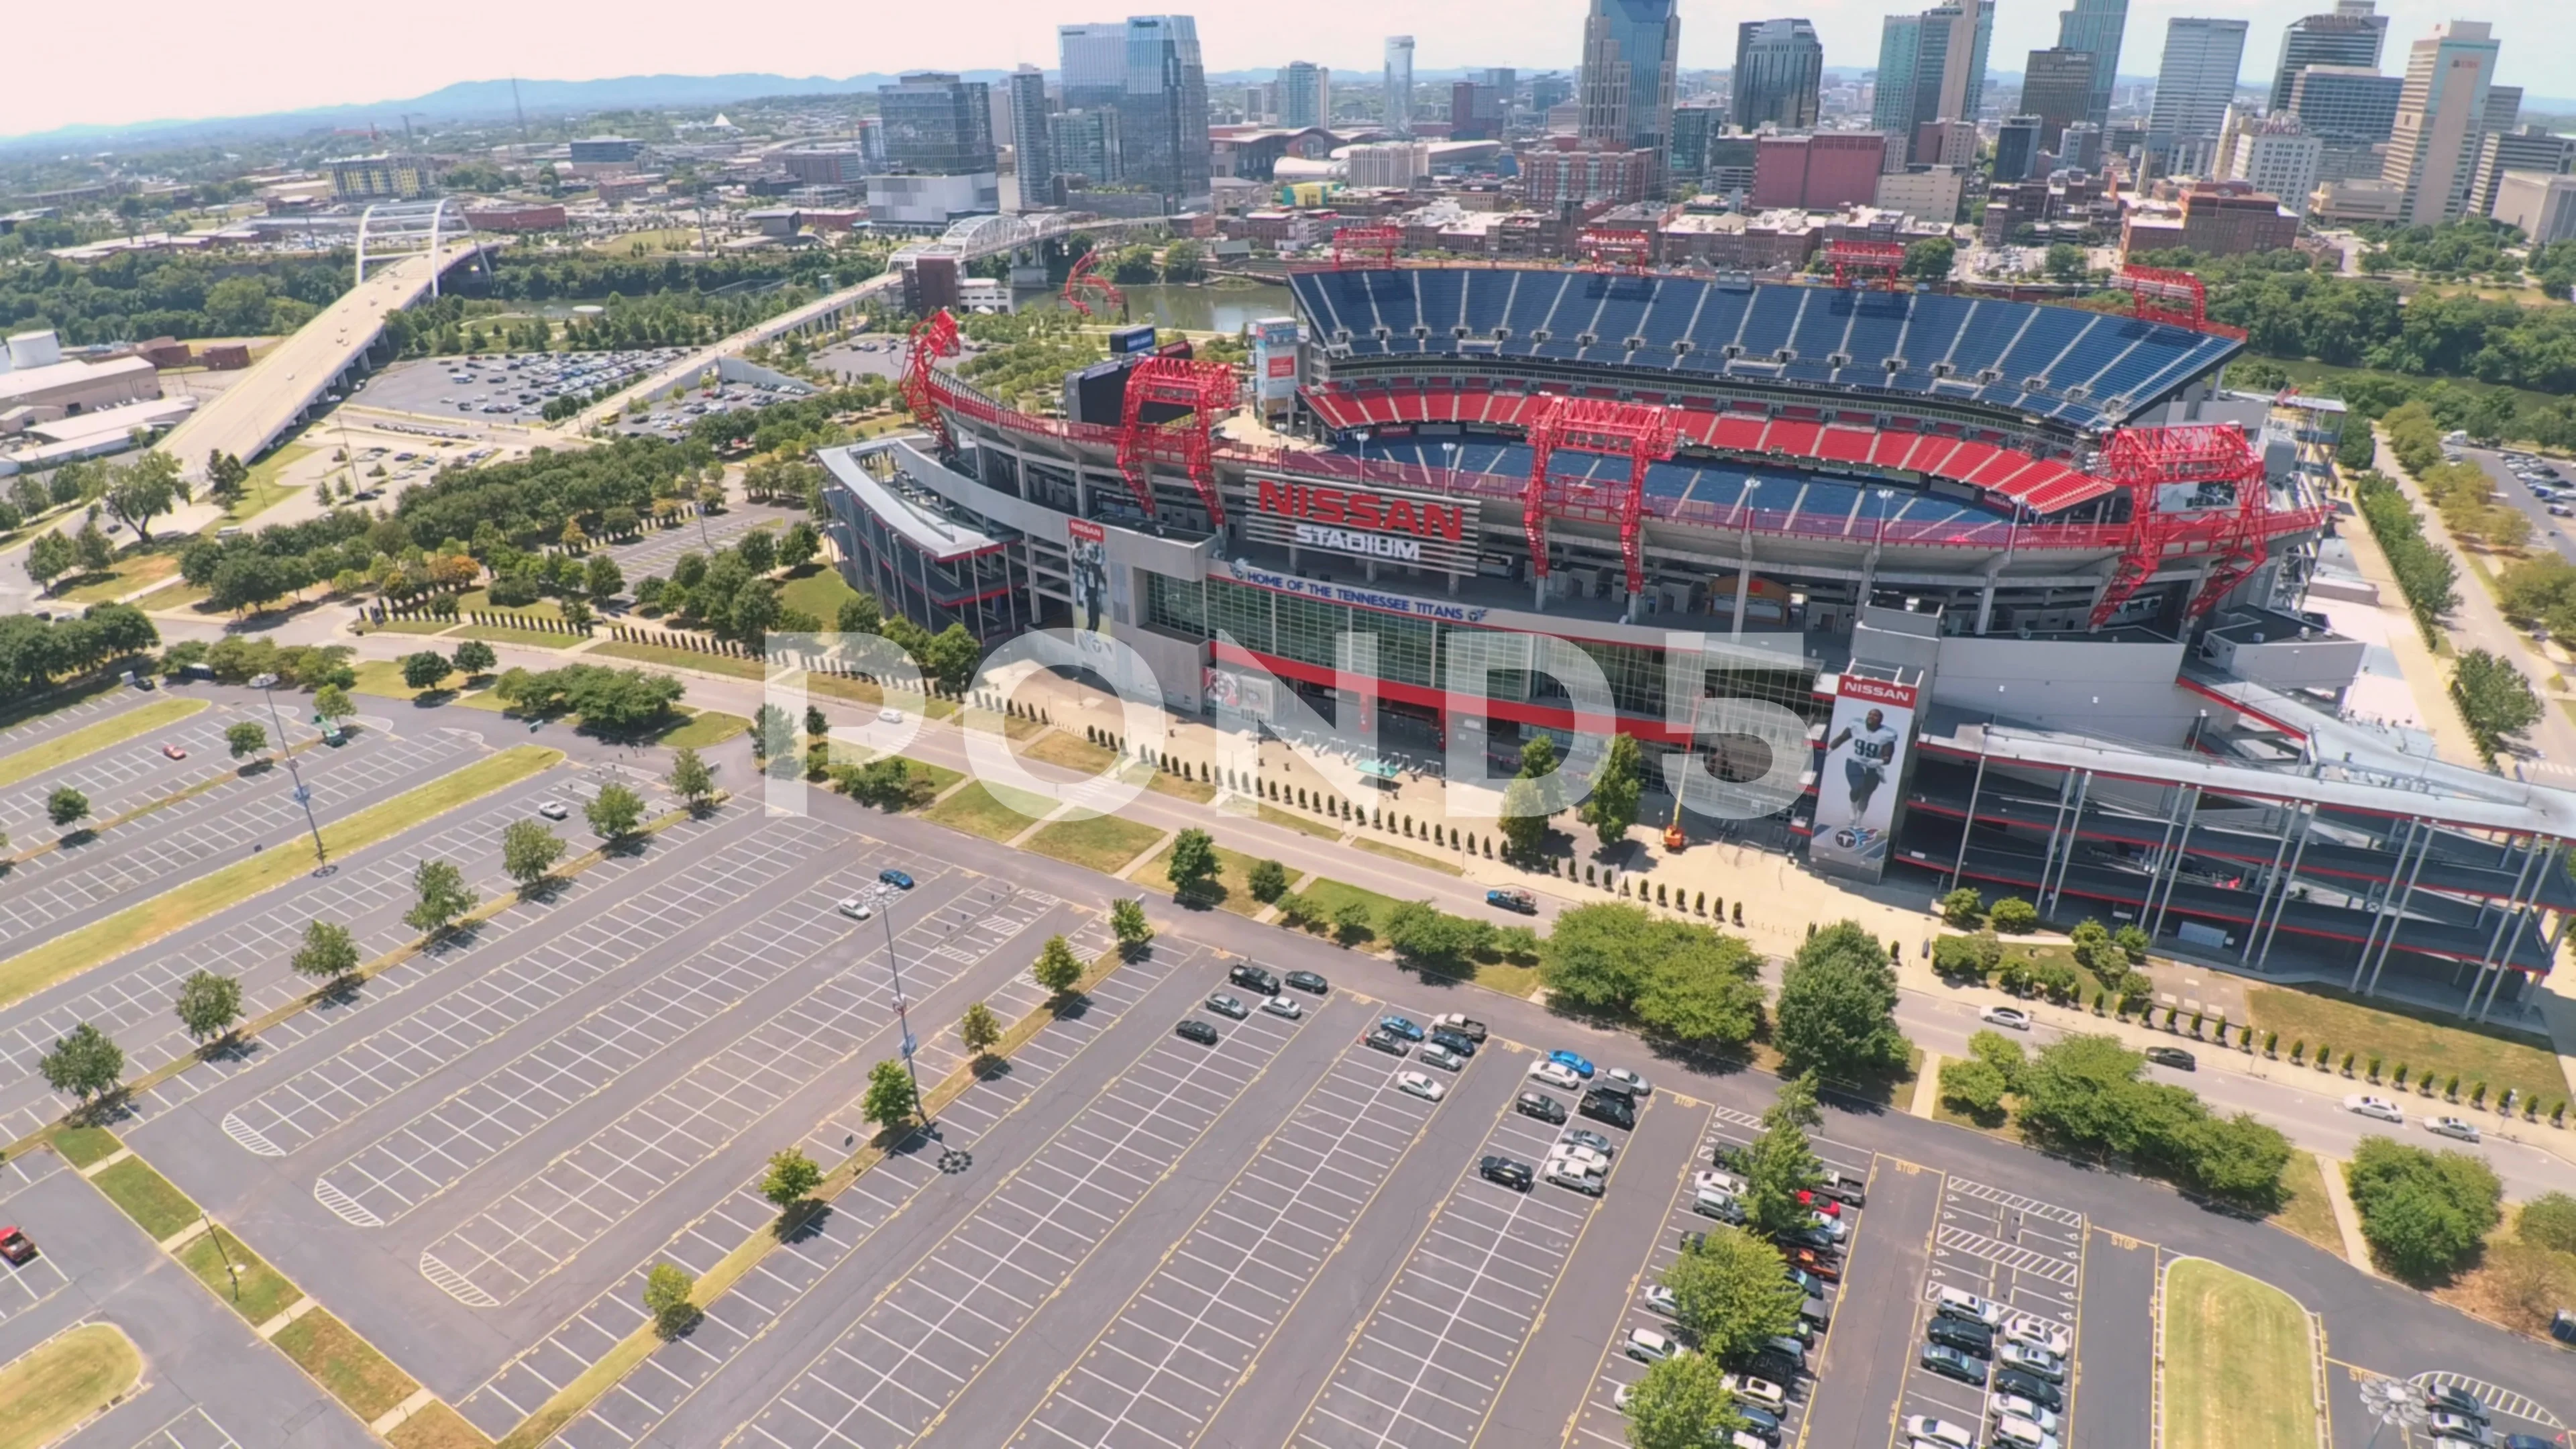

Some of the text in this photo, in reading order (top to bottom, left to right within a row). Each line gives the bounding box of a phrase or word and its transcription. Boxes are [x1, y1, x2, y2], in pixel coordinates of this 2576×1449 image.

[1258, 479, 1463, 541] NISSAN
[1071, 521, 1102, 537] NISSAN
[1295, 524, 1420, 561] STADIUM
[1247, 571, 1464, 621] HOME OF THE TENNESSEE TITANS
[1844, 682, 1910, 702] NISSAN
[1854, 739, 1879, 758] 99
[1894, 1159, 1921, 1175] STOP
[2110, 1233, 2138, 1250] STOP
